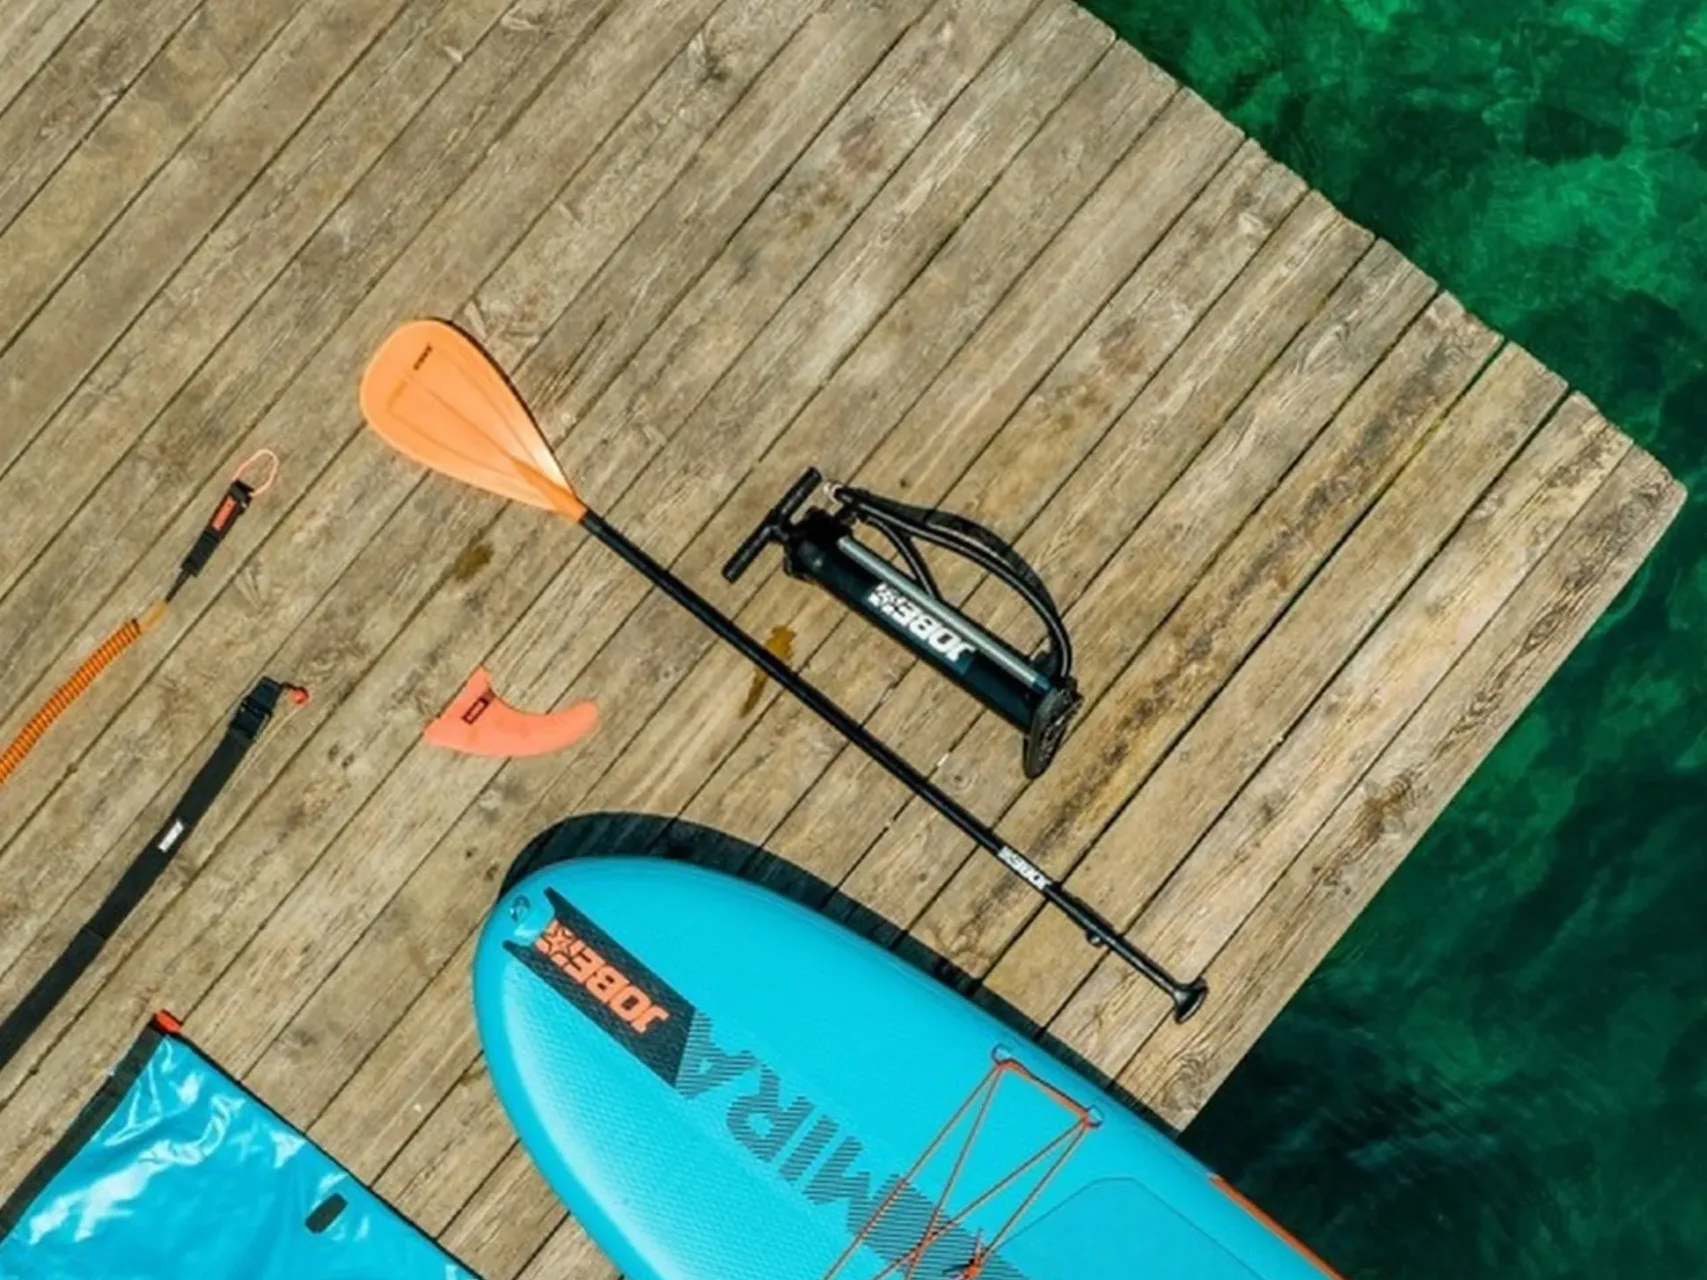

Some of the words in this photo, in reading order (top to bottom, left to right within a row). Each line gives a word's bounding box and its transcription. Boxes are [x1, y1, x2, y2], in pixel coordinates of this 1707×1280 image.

[889, 595, 976, 663] JOBE
[1006, 852, 1053, 890] JOBE
[561, 944, 670, 1034] JOBE
[674, 1009, 921, 1248] MIRA
